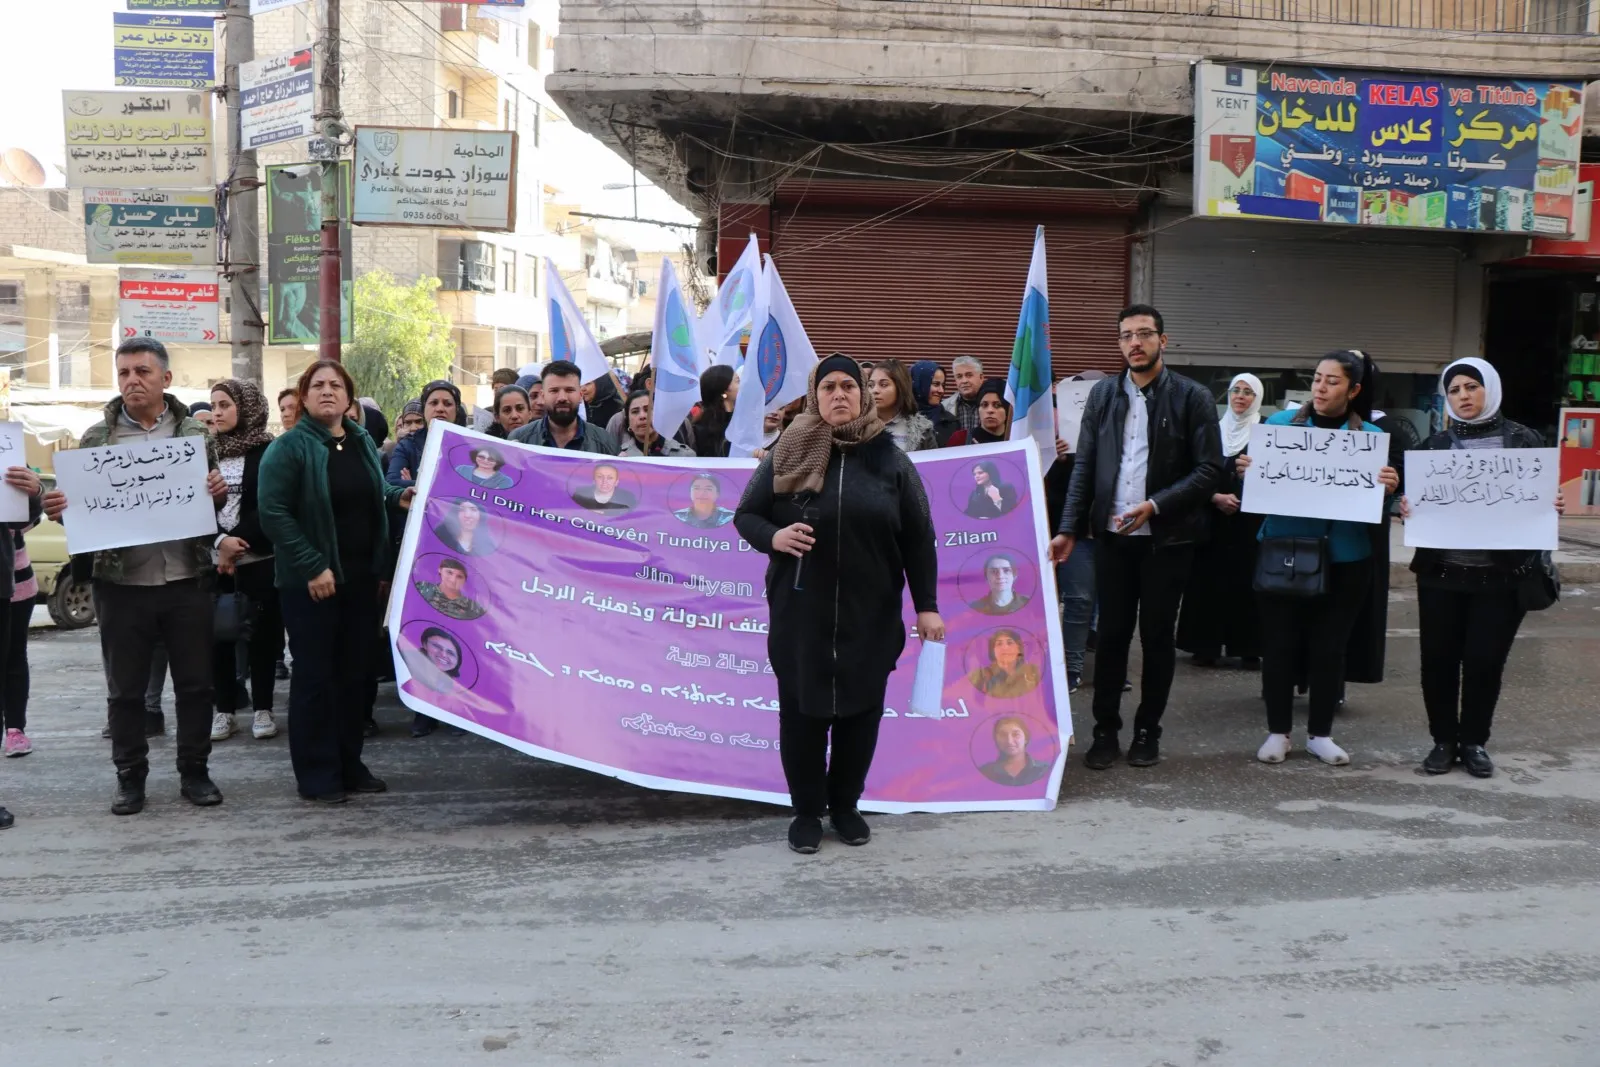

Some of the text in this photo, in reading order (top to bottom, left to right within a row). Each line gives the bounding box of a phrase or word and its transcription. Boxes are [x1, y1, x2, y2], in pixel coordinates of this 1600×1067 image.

[148, 16, 182, 25] الدكتور
[120, 32, 208, 46] ولات خليل عمر
[260, 87, 274, 104] حاج
[275, 80, 295, 100] الرزاق
[296, 79, 310, 94] عبد
[1271, 72, 1537, 108] Navenda KELAS ya Titûnê
[121, 97, 171, 115] الدكتور
[1216, 97, 1249, 110] KENT
[136, 123, 181, 141] الرحمن
[183, 125, 206, 140] عبد
[1258, 97, 1538, 150] مركز كلاس للدخان
[70, 147, 207, 162] دكتور في طب الأسنان وجراحتها
[453, 143, 504, 159] المحامية
[1280, 144, 1343, 168] وطني
[1447, 150, 1507, 172] كوتا
[405, 167, 456, 182] جودت
[462, 165, 508, 184] سوزان
[1363, 170, 1432, 190] جملة مفرق
[132, 192, 169, 205] القابلة
[117, 206, 200, 227] ليلى حسن
[403, 211, 424, 220] 0935
[114, 228, 130, 237] حمل
[132, 228, 155, 239] مراقبة
[165, 229, 186, 239] توليد
[123, 283, 215, 301] شاهي محمد علي
[1266, 428, 1313, 455] الحياة
[1315, 432, 1336, 455] هي
[121, 446, 165, 469] شمال
[108, 472, 165, 493] سوريا
[470, 488, 488, 503] Li
[531, 506, 565, 524] Her
[571, 514, 649, 544] Cûreyên
[656, 532, 731, 552] Tundiya
[944, 529, 997, 546] Zilam
[635, 565, 674, 585] Jin
[683, 572, 754, 598] Jiyan
[521, 576, 769, 635] عنف الدولة وذهنية الرجل
[666, 646, 711, 668] حرية
[716, 653, 759, 675] حياة
